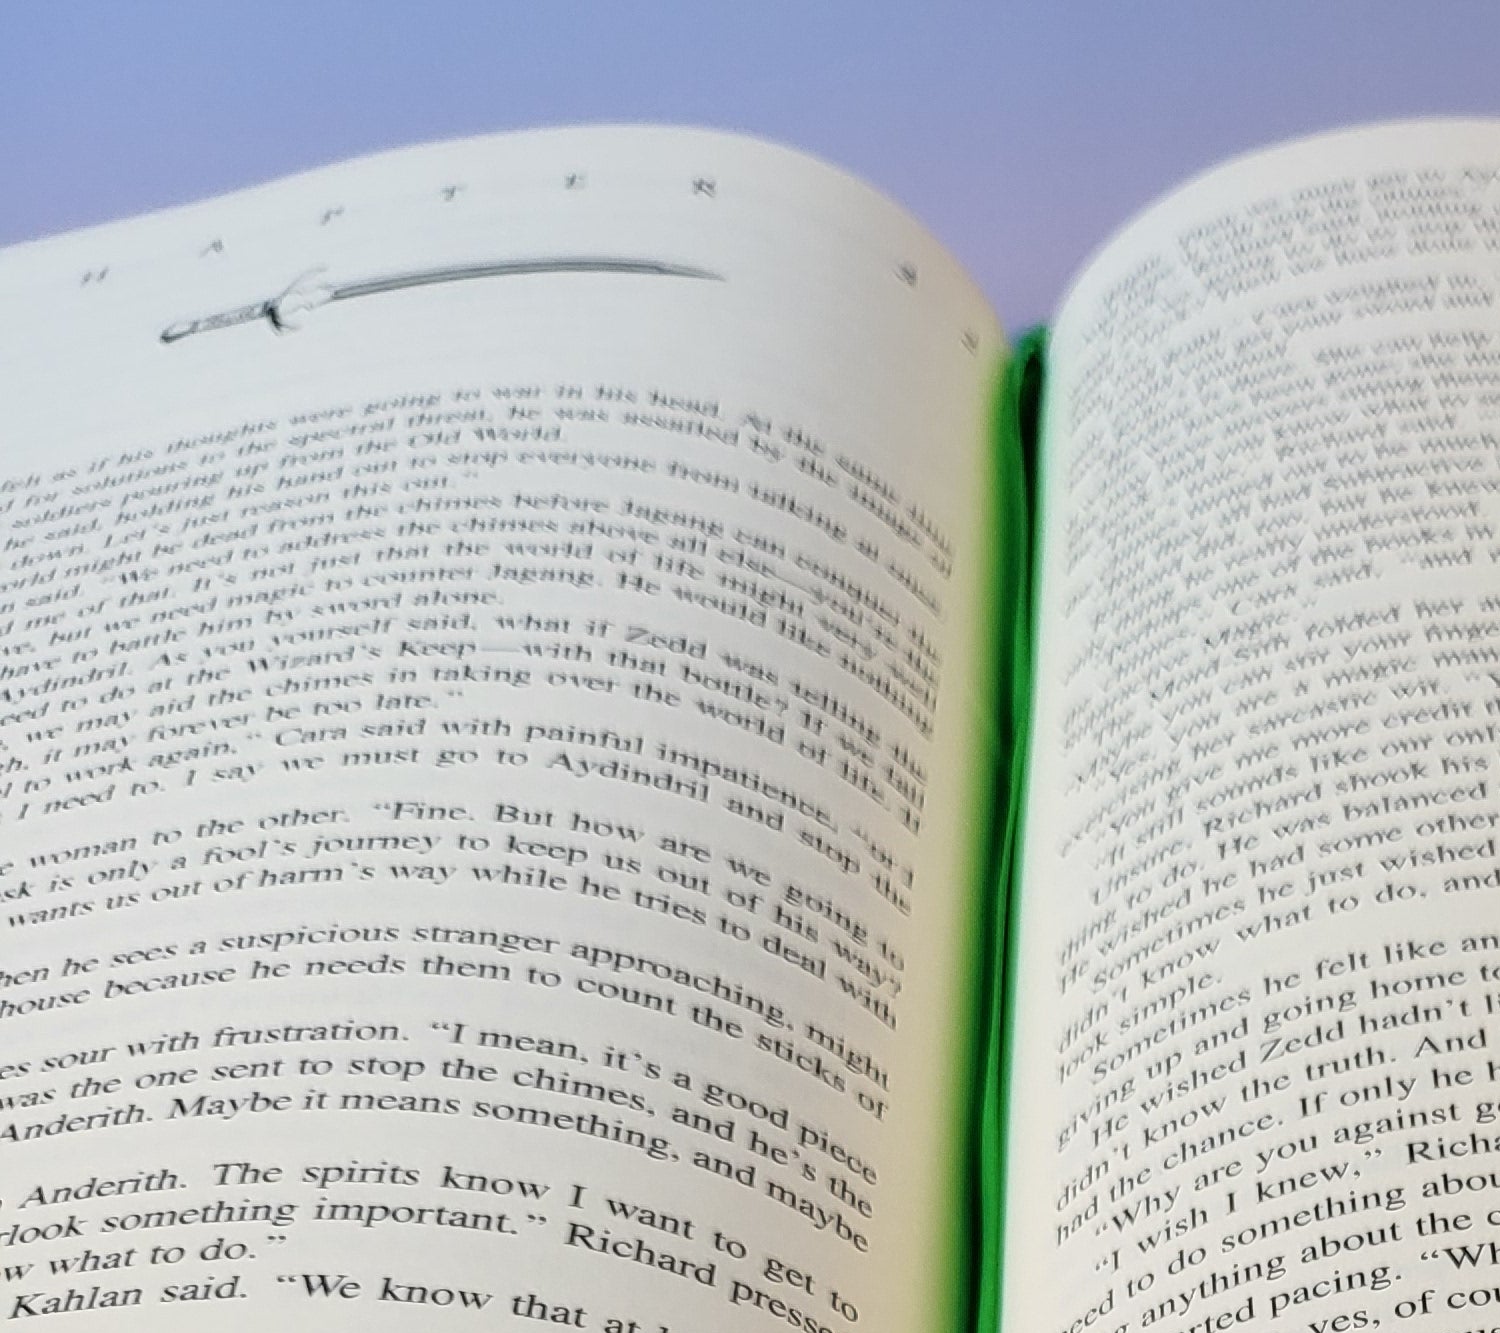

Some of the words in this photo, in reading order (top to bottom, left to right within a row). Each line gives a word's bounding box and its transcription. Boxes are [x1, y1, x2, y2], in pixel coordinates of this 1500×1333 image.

[1193, 1160, 1243, 1192] are
[1255, 1134, 1318, 1175] you
[1333, 1102, 1462, 1145] against
[16, 1168, 188, 1210] Anderith.
[212, 1161, 284, 1187] The
[301, 1159, 421, 1190] spirits
[439, 1165, 551, 1201] know
[567, 1183, 588, 1210] I
[604, 1197, 697, 1241] want
[712, 1230, 748, 1260] to
[761, 1256, 816, 1297] get
[828, 1289, 859, 1323] to
[99, 1197, 300, 1233] something
[312, 1195, 548, 1236] important.”
[563, 1220, 717, 1288] Richard
[6, 1285, 144, 1320] Kahlan
[159, 1274, 248, 1303] said.
[275, 1273, 362, 1300] “We
[376, 1276, 495, 1310] know
[511, 1293, 589, 1329] that
[1268, 1265, 1402, 1321] pacing.
[1393, 1288, 1436, 1319] of
